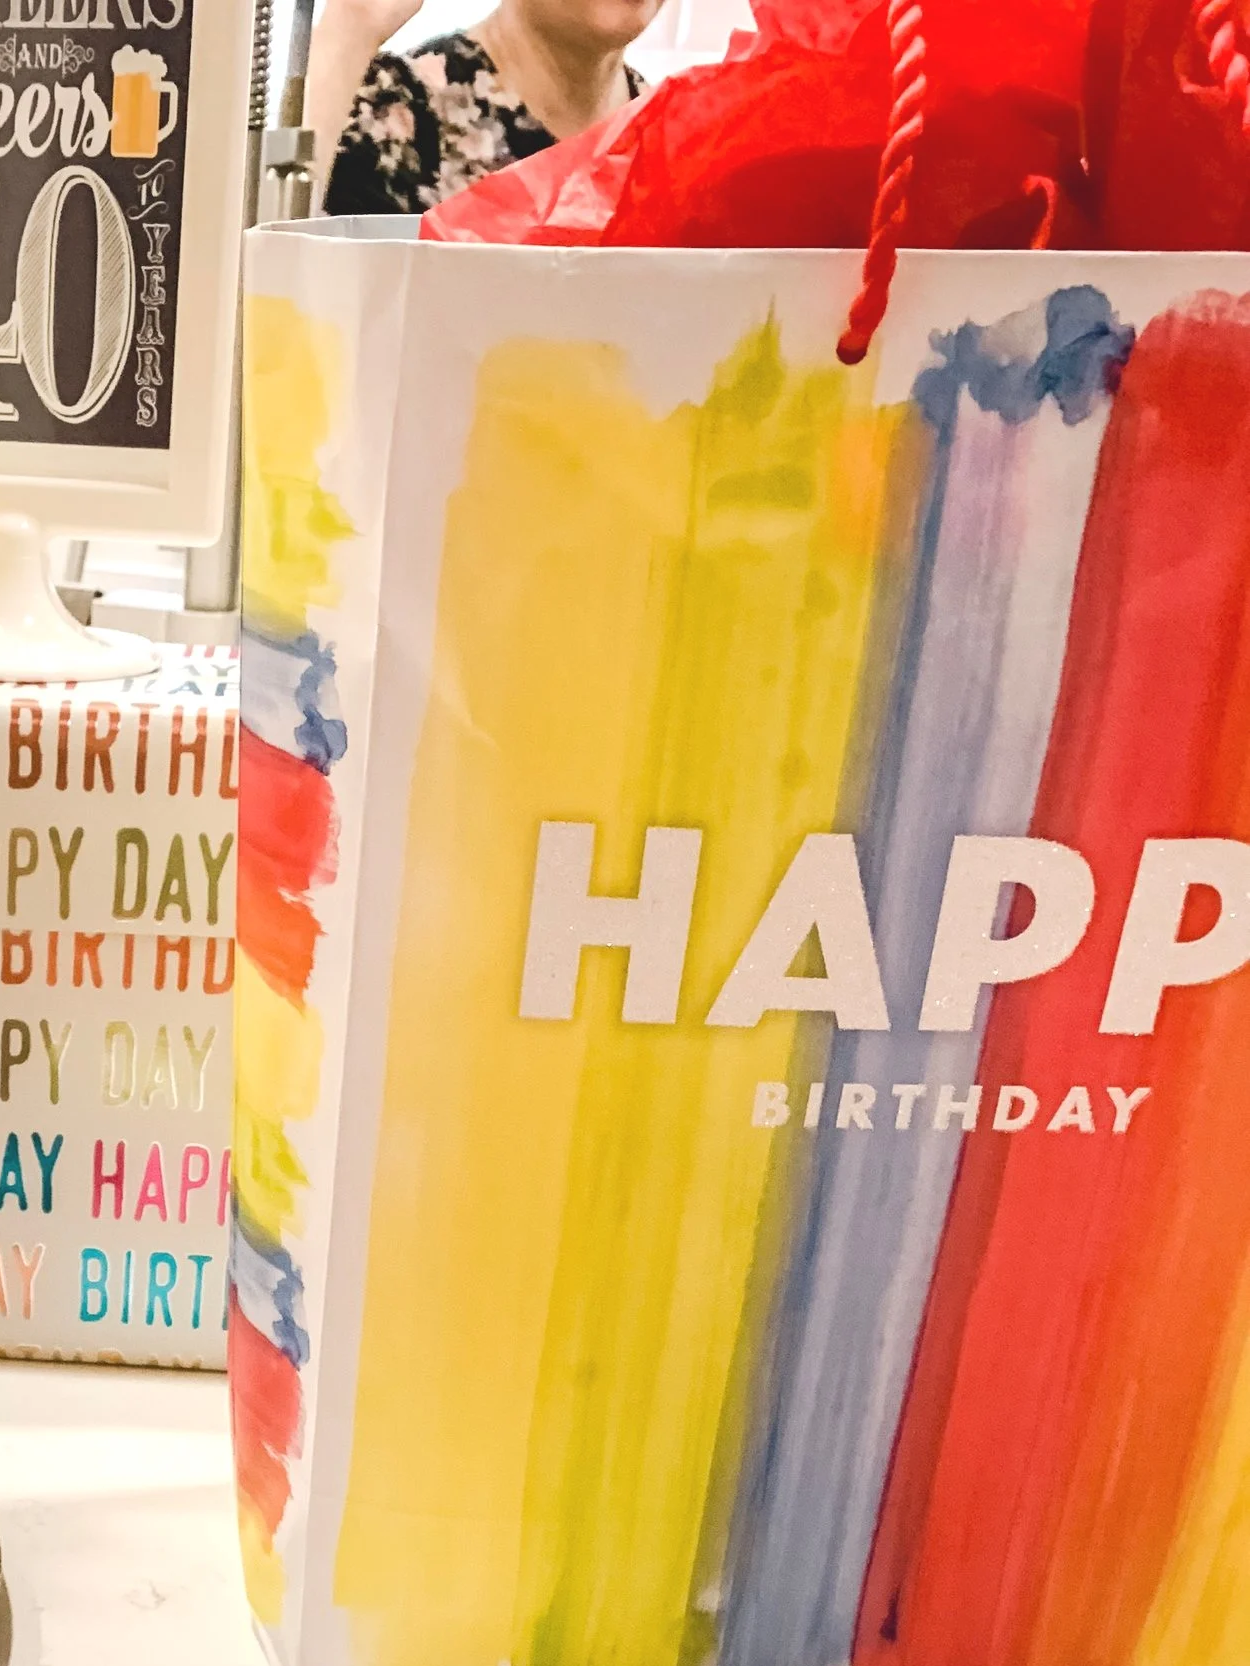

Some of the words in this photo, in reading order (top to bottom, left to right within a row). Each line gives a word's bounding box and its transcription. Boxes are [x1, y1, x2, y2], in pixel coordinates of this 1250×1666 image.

[16, 43, 62, 69] AND
[137, 173, 165, 206] TO
[134, 223, 171, 427] YEARS
[112, 827, 234, 926] DAY
[103, 1020, 217, 1112] DAY
[750, 1081, 1151, 1133] BIRTHDAY
[79, 1247, 230, 1331] BIRT
